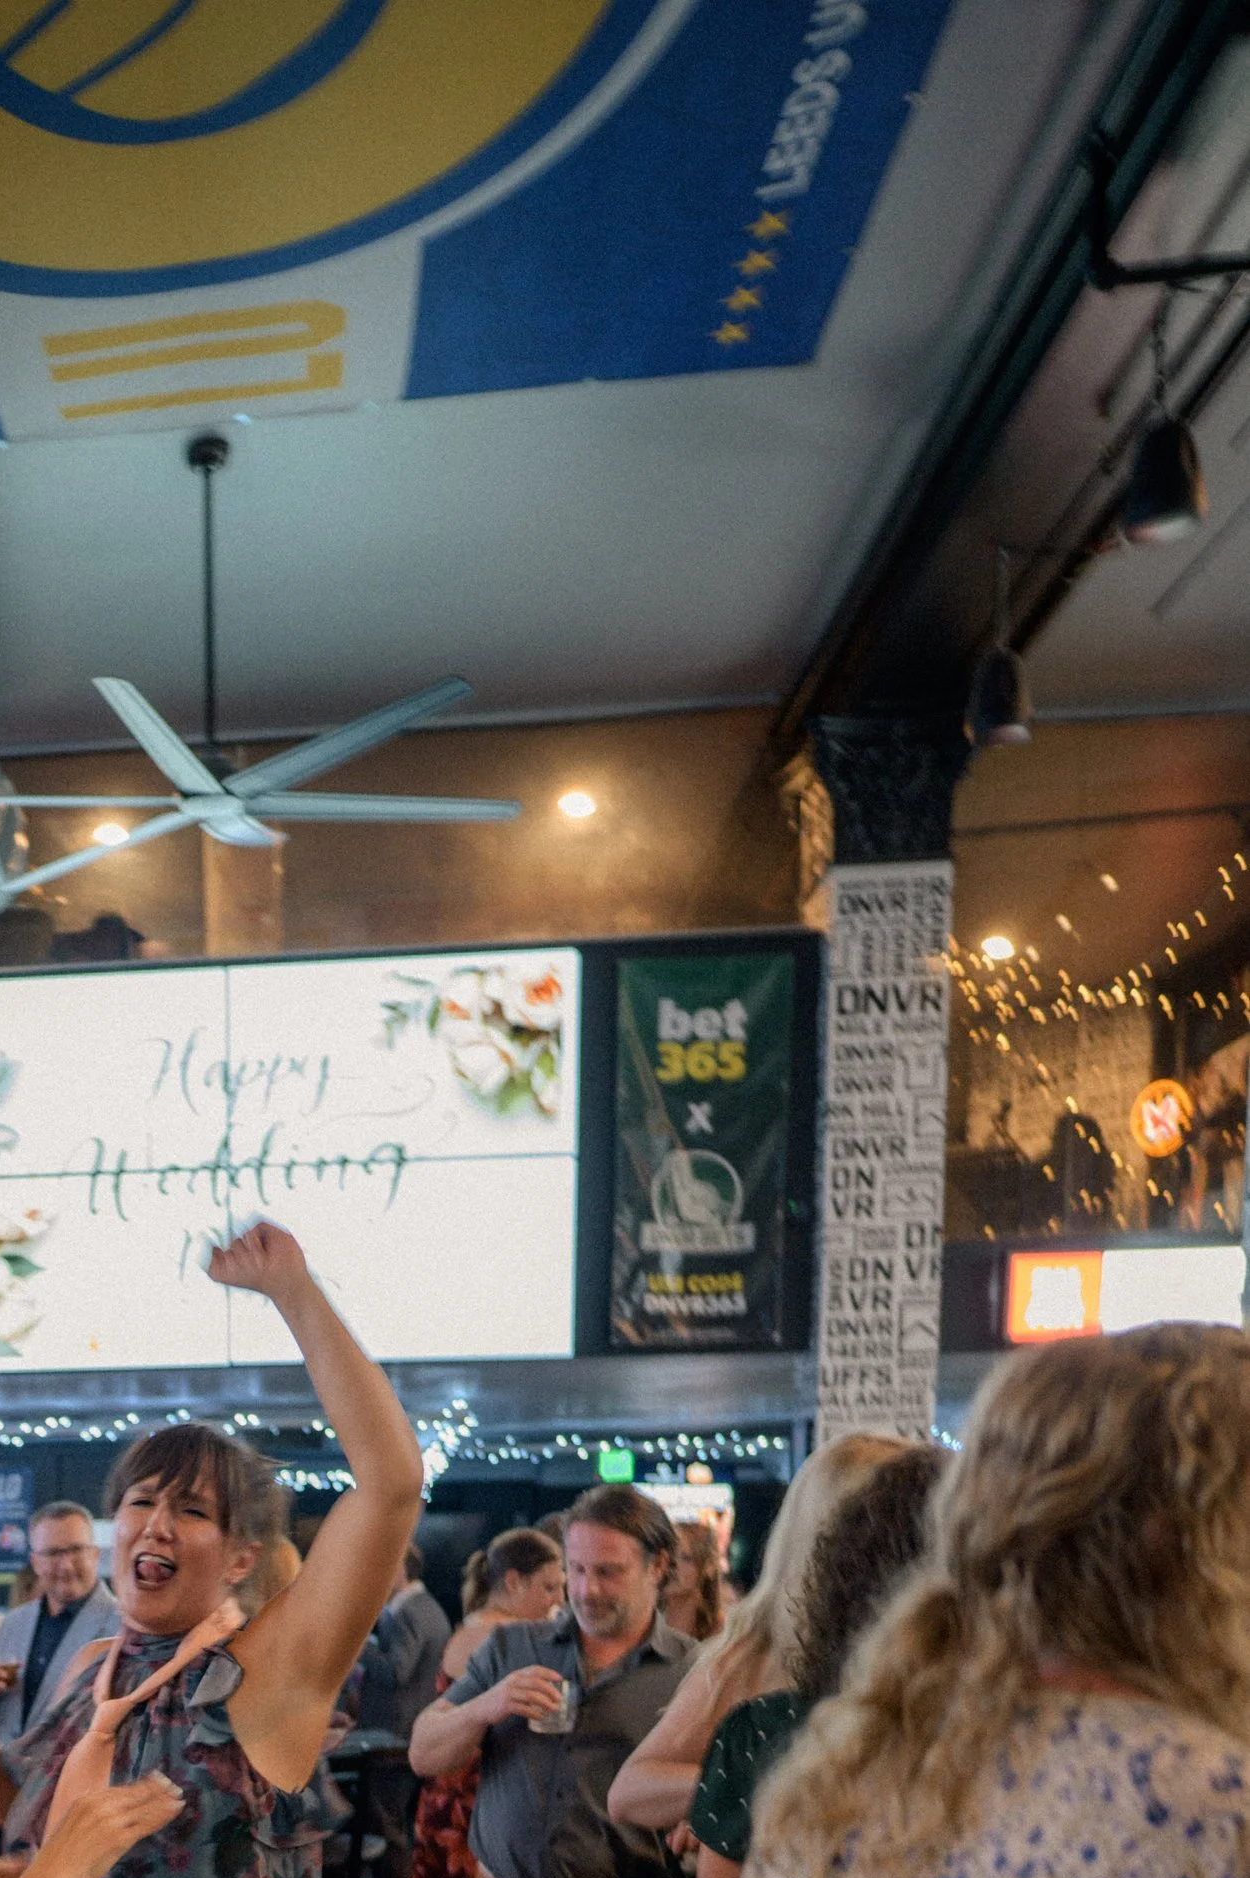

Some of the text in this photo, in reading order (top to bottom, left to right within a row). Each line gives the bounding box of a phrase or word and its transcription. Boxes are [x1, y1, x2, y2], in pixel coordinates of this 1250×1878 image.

[753, 49, 853, 202] LEEDS
[836, 981, 943, 1015] DNVR
[657, 997, 749, 1042] bet
[655, 1041, 747, 1084] 365
[85, 1122, 412, 1222] Wedding
[831, 1166, 874, 1191] DN
[831, 1194, 874, 1219] VR
[848, 1257, 893, 1282] DN
[848, 1286, 892, 1311] VR
[821, 1363, 893, 1389] UFFS
